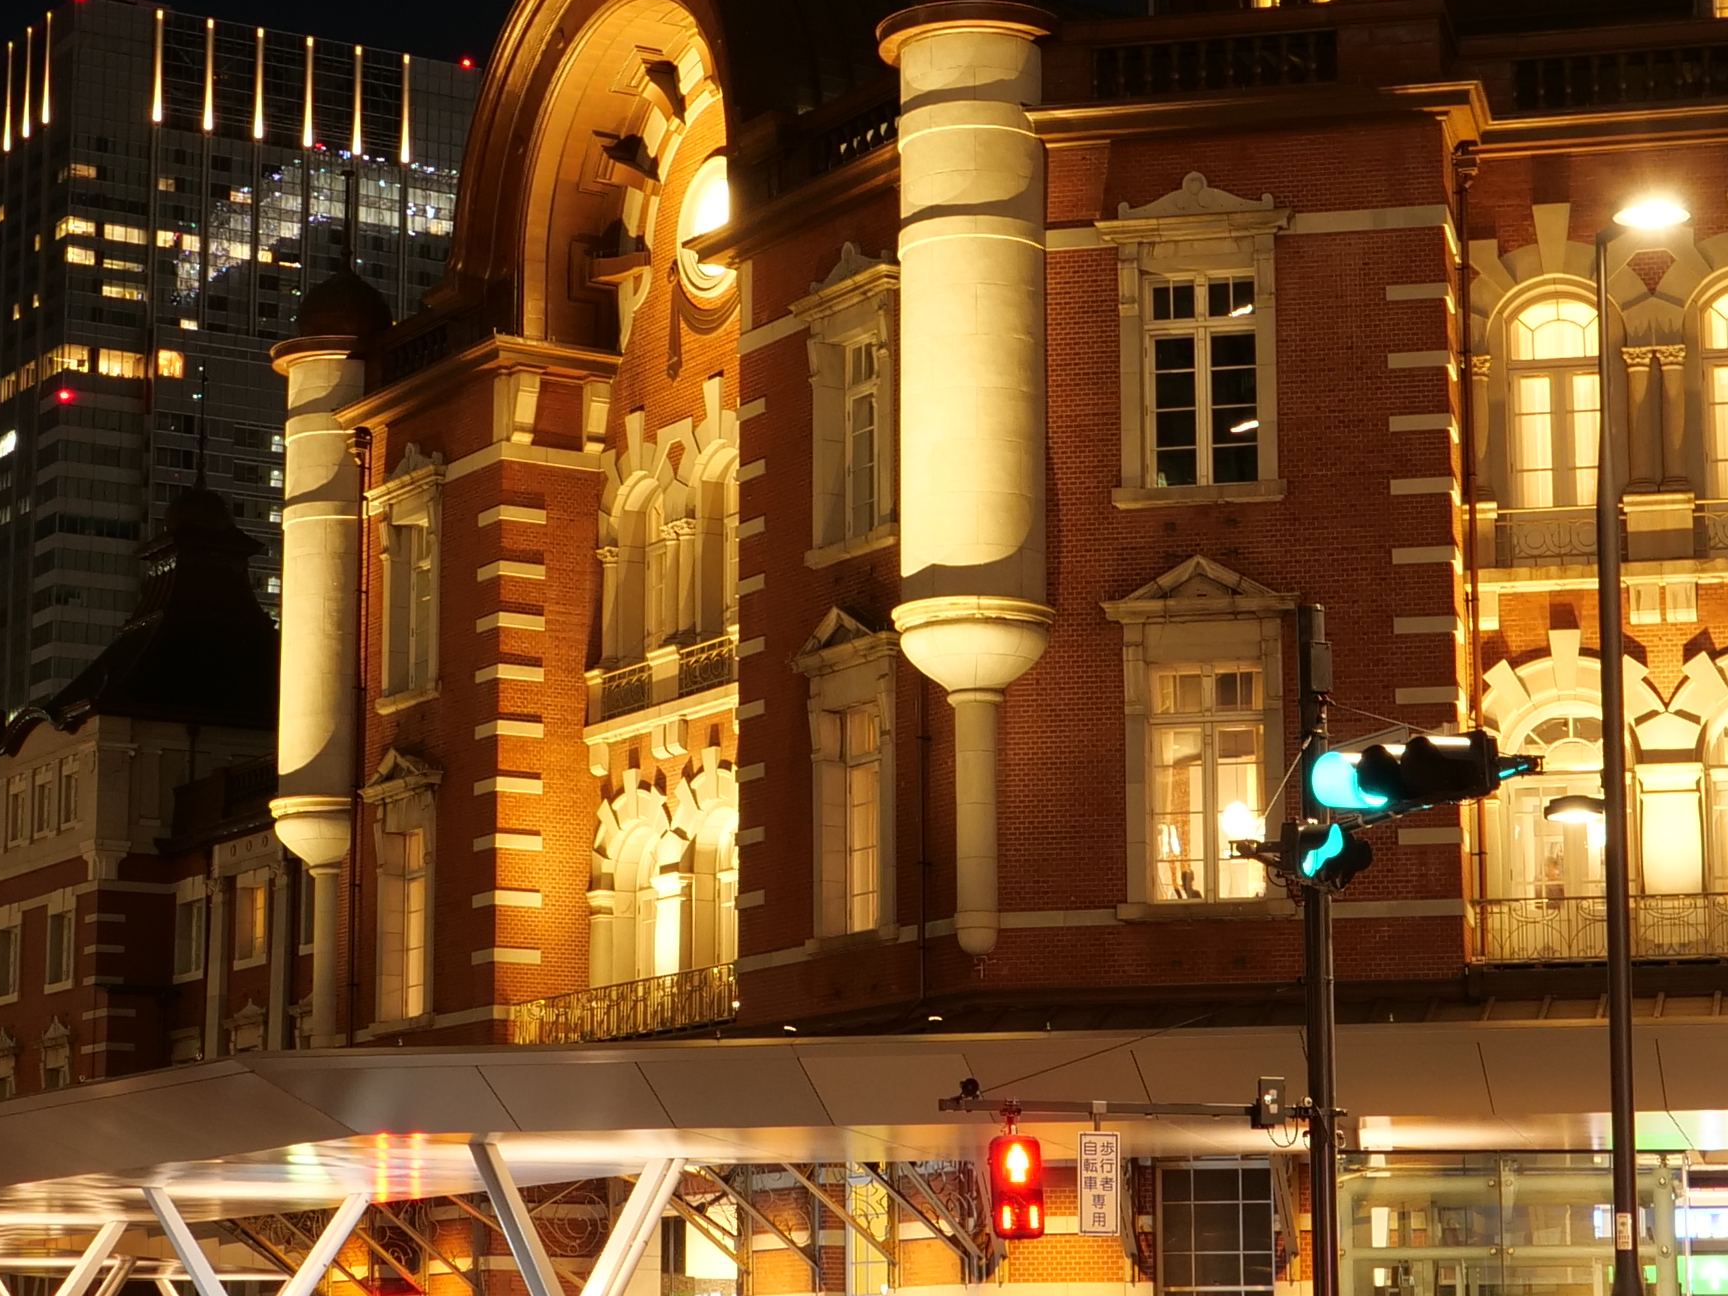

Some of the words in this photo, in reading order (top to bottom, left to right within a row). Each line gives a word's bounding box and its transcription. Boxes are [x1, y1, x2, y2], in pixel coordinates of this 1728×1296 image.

[1083, 1140, 1098, 1192] 自転車
[1100, 1140, 1115, 1192] 歩行者
[1091, 1194, 1107, 1227] 専用
